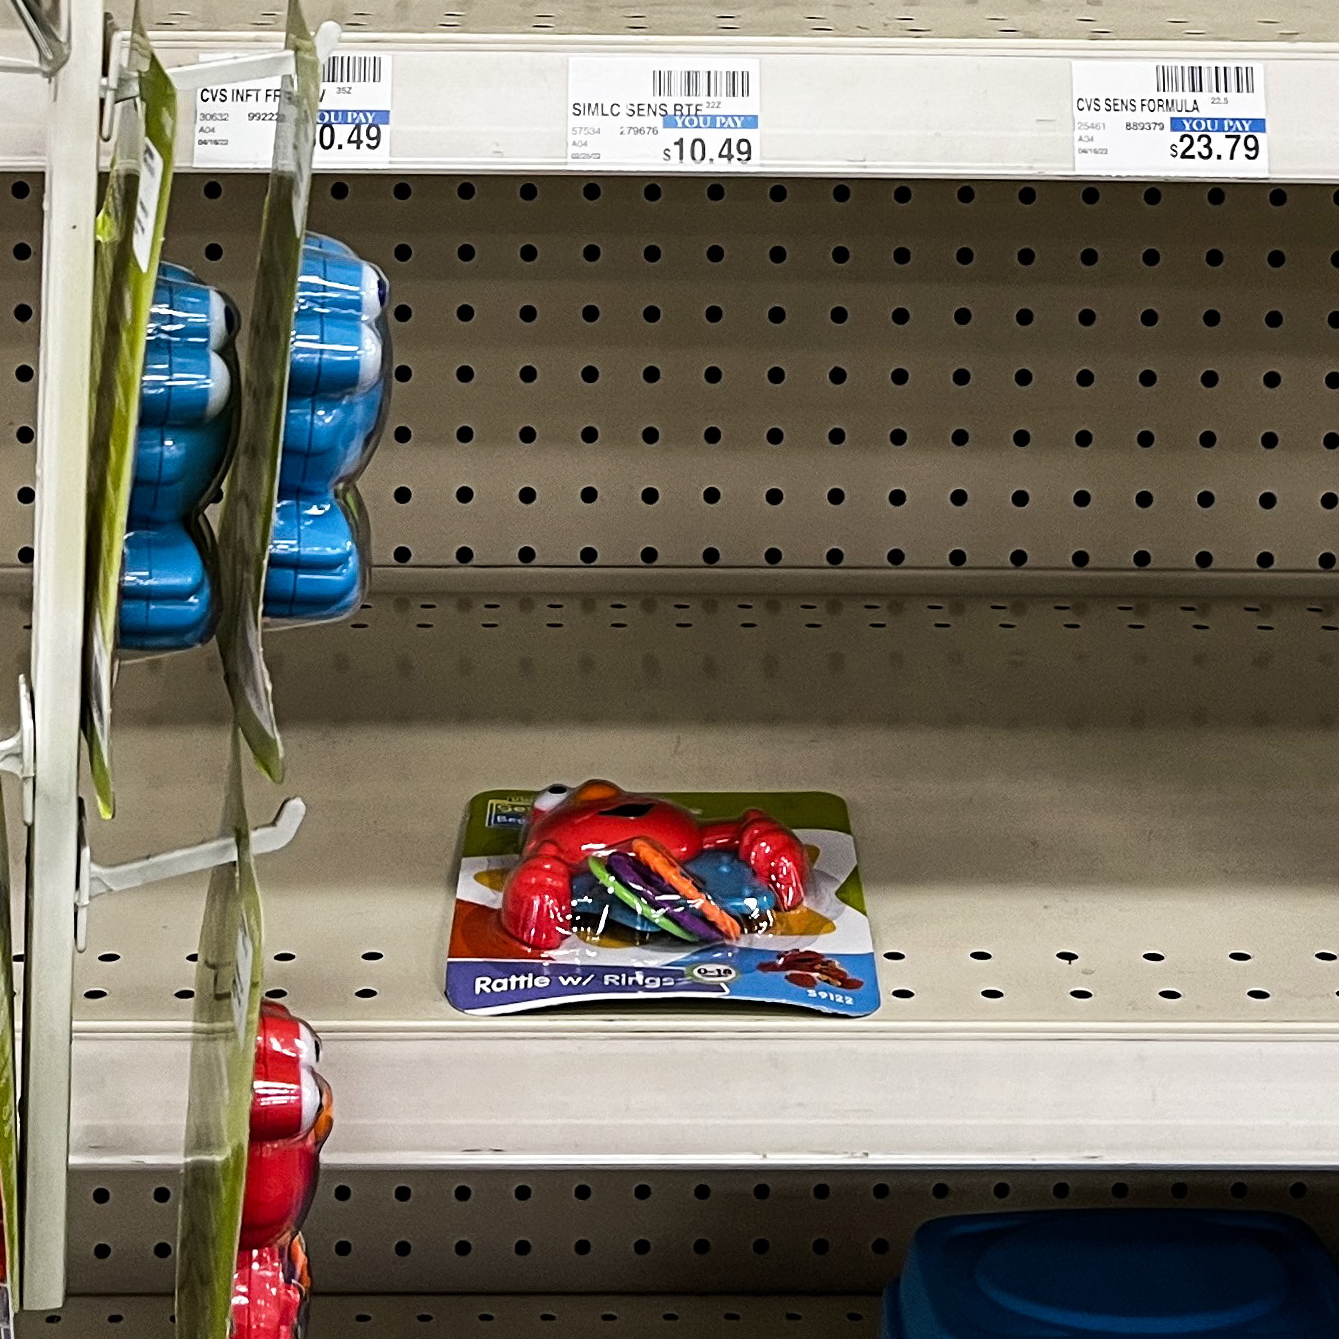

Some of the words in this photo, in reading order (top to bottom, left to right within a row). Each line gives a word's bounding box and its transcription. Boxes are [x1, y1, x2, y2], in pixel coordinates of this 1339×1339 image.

[200, 89, 227, 103] CVS
[231, 89, 261, 103] INFT
[572, 103, 621, 117] SIMLC
[1076, 98, 1101, 112] CVS
[1104, 98, 1137, 112] SENS
[1140, 99, 1200, 113] FORMULA
[347, 112, 375, 123] PAY
[1182, 120, 1218, 131] YOU
[1224, 120, 1253, 131] PAY
[663, 137, 752, 164] $10.49
[1169, 134, 1260, 160] $23.79
[474, 973, 551, 995] Rattle
[559, 973, 595, 987] w/
[603, 972, 676, 988] Rings
